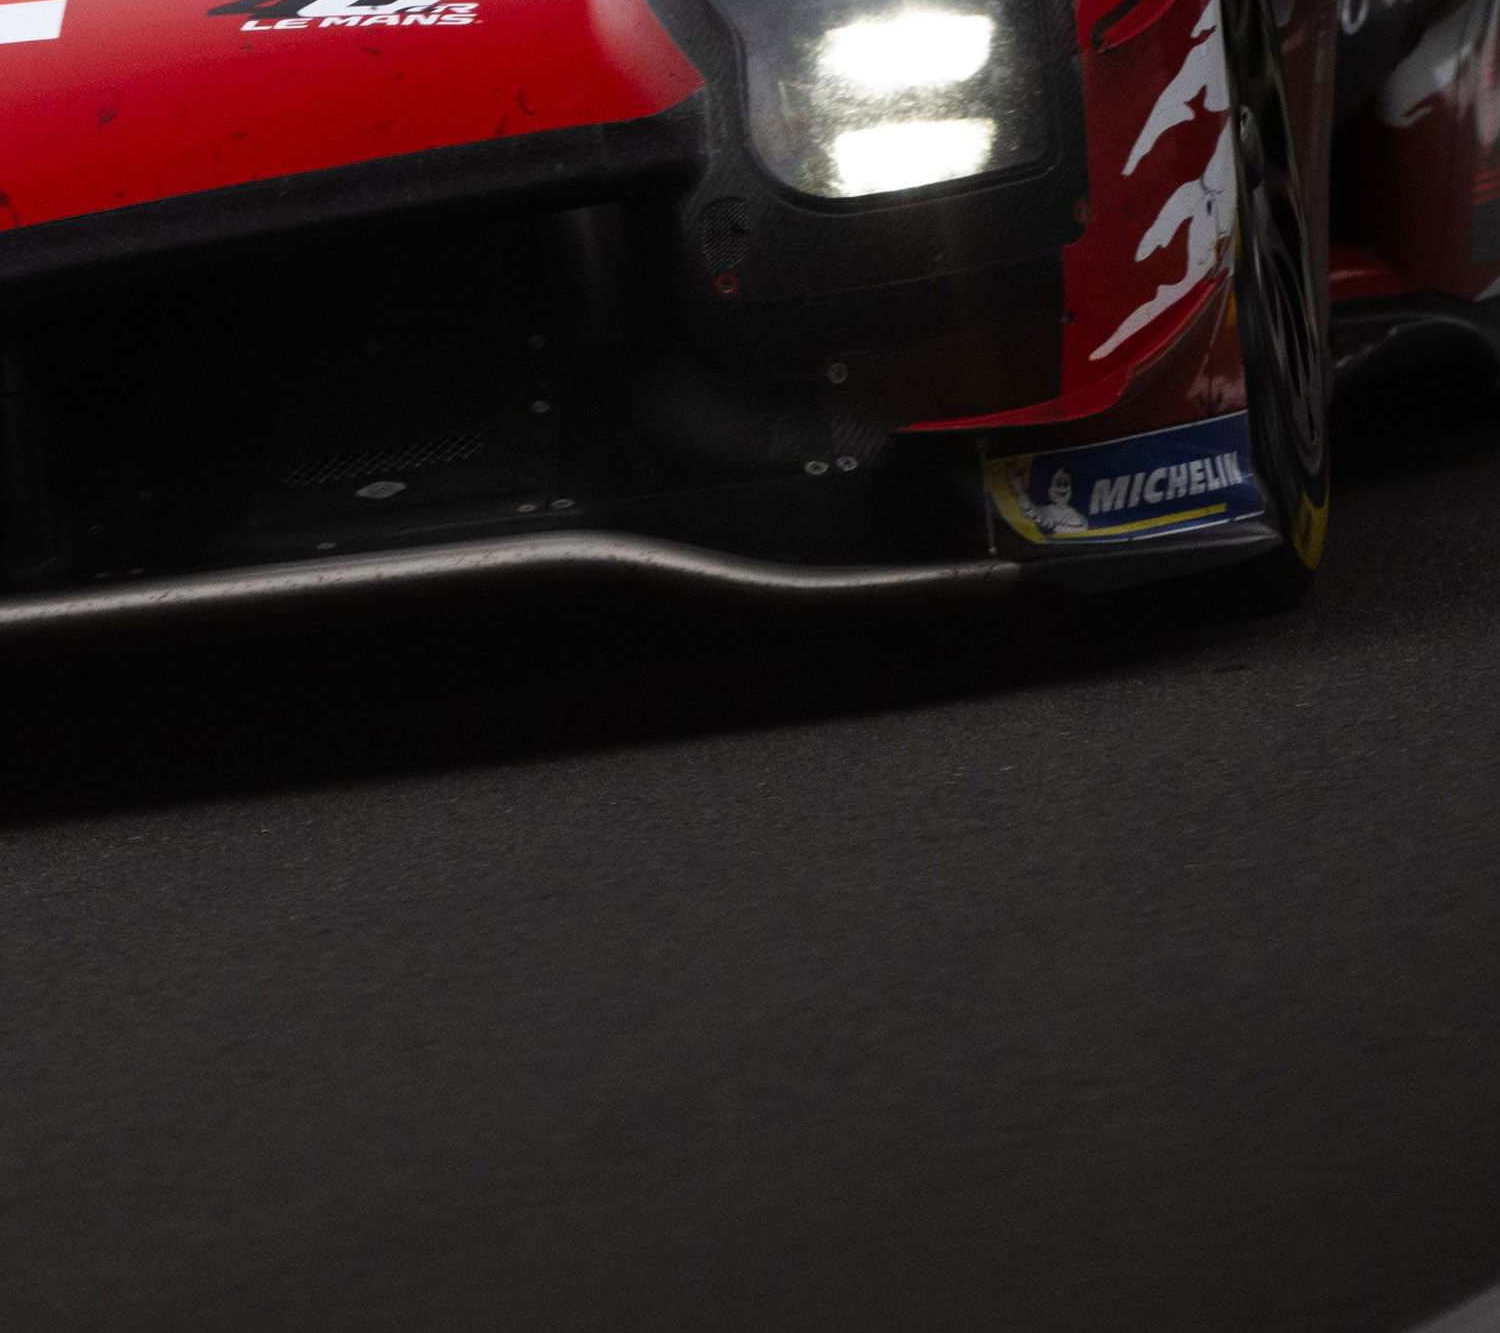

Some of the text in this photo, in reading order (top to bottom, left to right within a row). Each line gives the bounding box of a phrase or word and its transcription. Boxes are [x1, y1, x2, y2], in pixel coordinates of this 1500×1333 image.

[240, 13, 478, 32] LE MANS
[1088, 450, 1244, 516] MICHELIN
